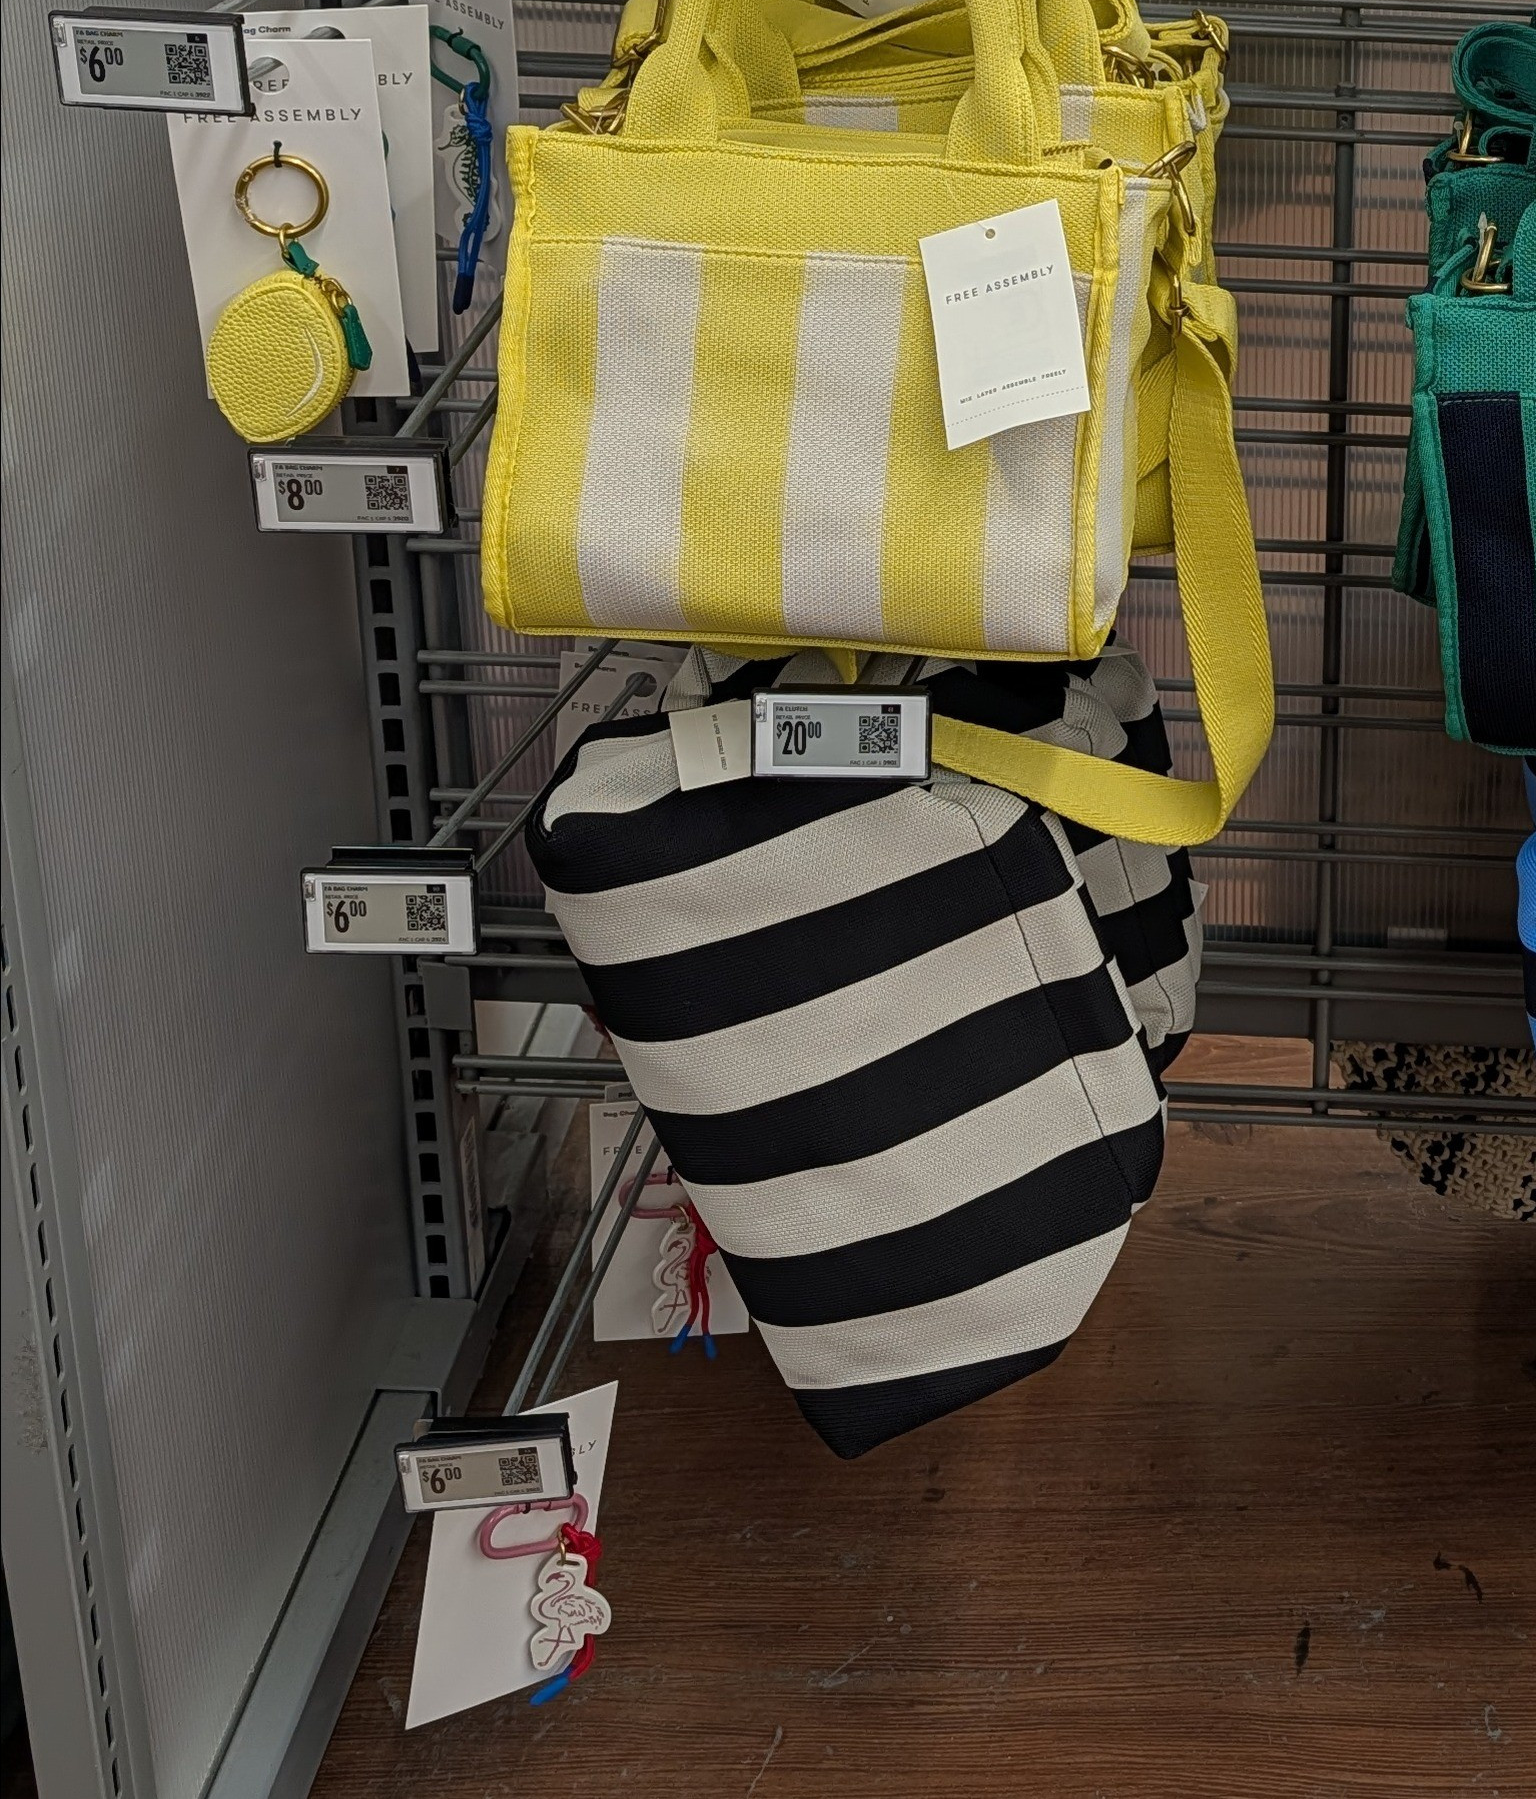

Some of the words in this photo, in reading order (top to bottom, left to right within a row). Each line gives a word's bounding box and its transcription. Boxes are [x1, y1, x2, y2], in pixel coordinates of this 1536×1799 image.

[243, 26, 256, 36] ag
[258, 24, 291, 34] Charm
[250, 108, 361, 123] ASSEMBLY
[945, 287, 979, 305] FREE
[985, 264, 1055, 294] ASSEMBLY
[603, 1145, 642, 1156] FRE
